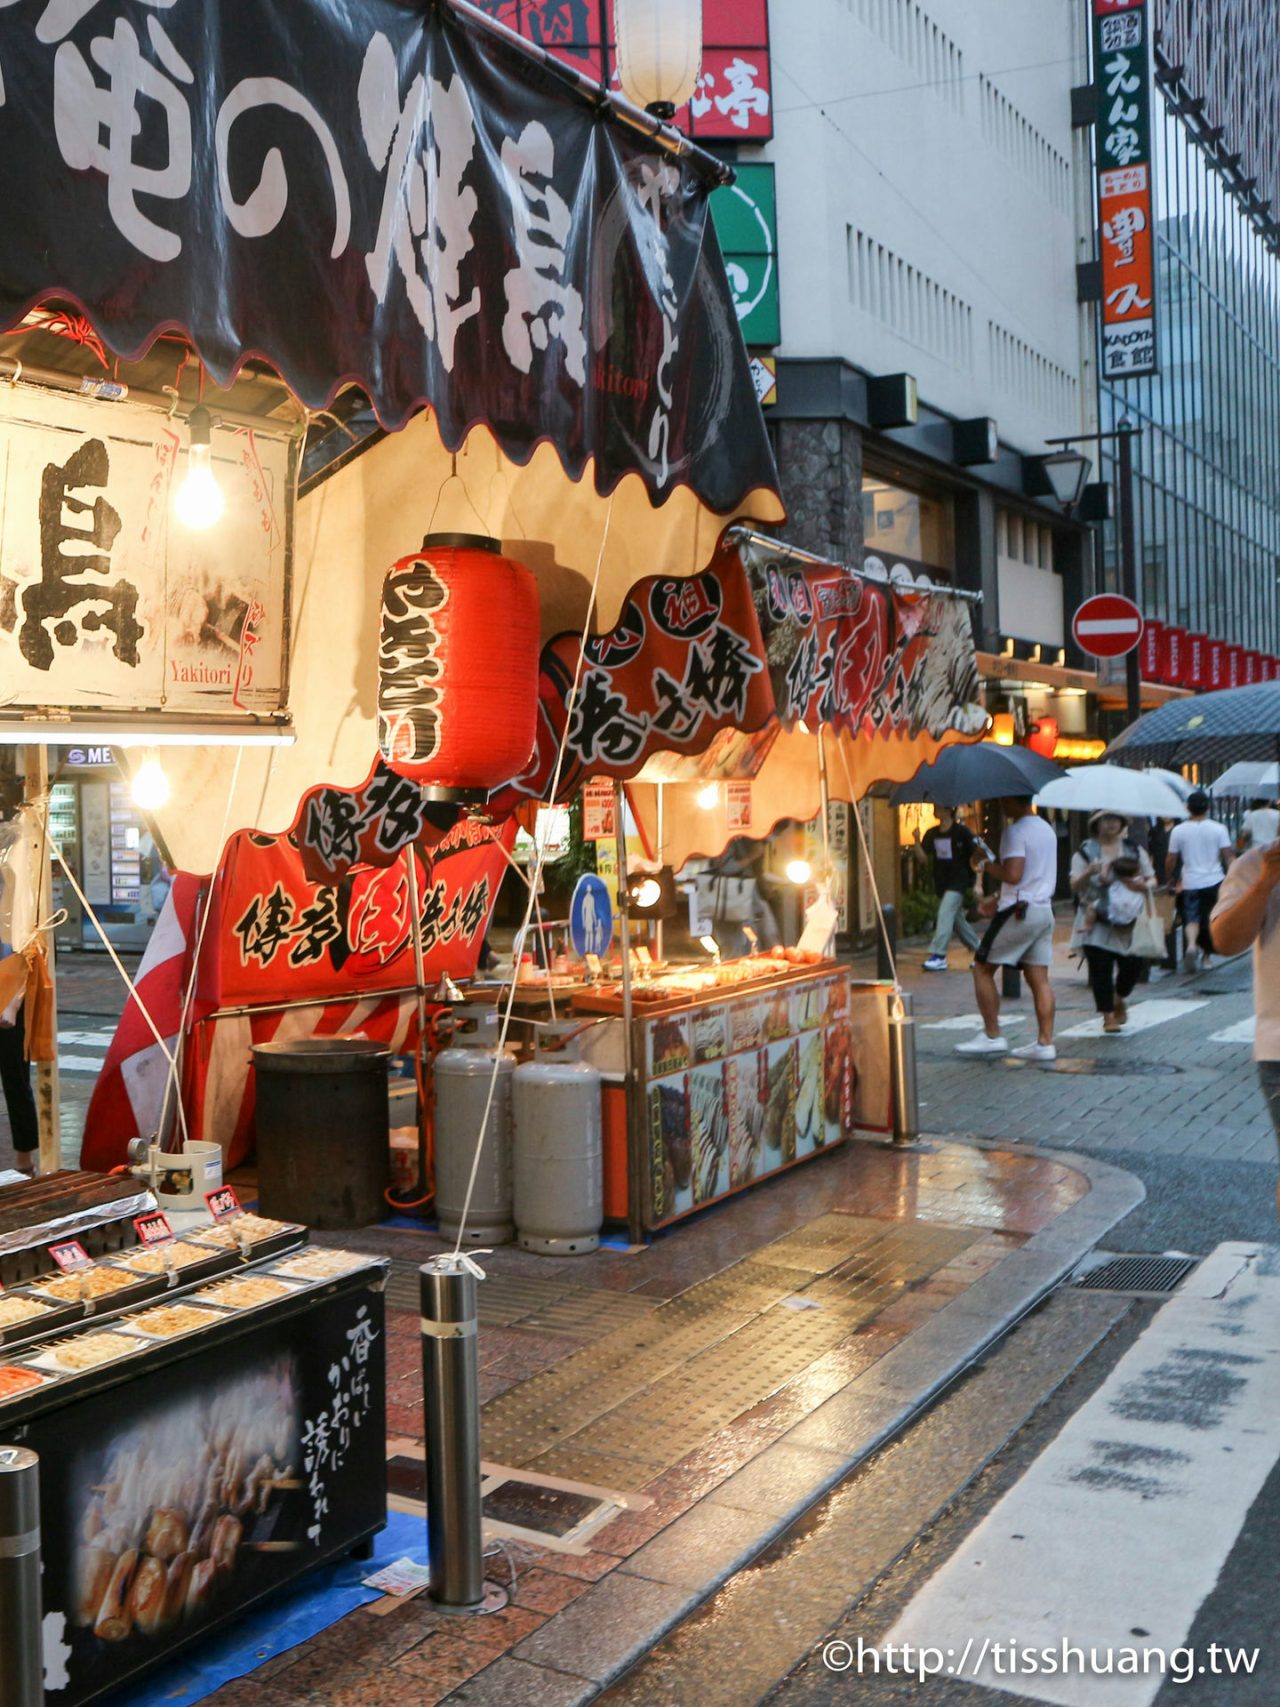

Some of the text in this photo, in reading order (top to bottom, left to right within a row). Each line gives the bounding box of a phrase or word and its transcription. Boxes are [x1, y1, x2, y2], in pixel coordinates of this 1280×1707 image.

[1104, 52, 1141, 166] えん家
[170, 659, 232, 686] Yakitori
[377, 559, 449, 764] やきとり
